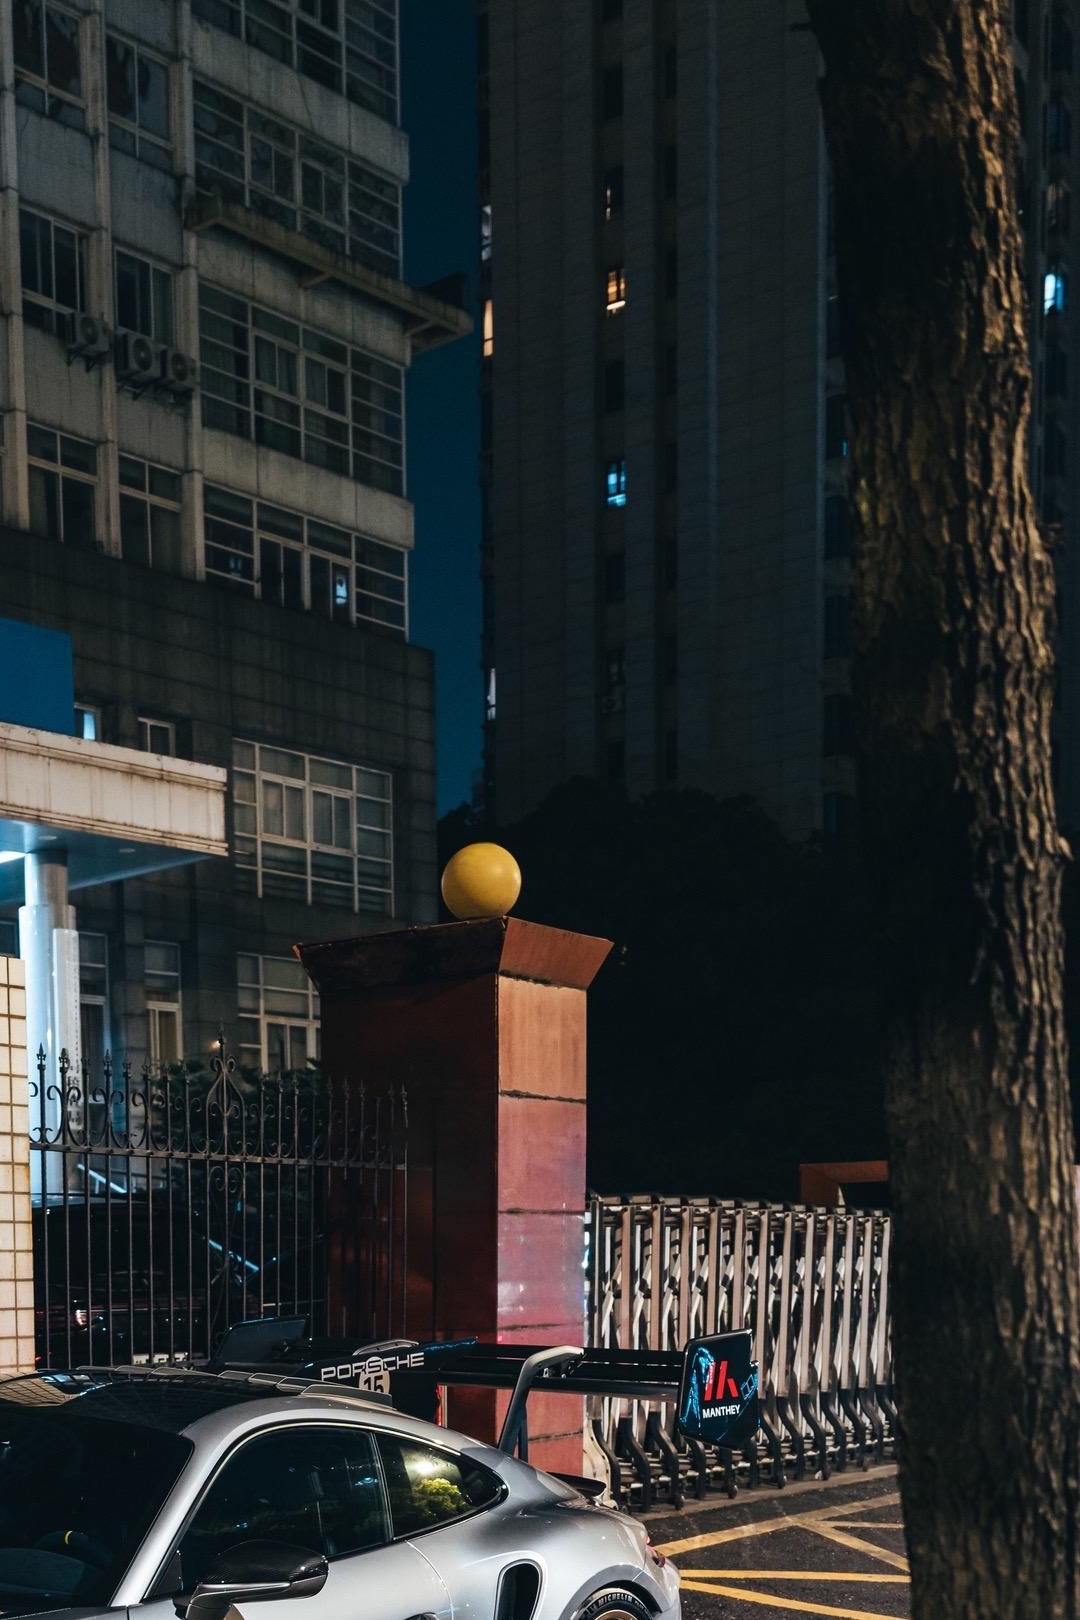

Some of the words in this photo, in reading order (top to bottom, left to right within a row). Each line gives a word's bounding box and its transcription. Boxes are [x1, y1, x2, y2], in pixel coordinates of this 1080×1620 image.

[321, 1351, 425, 1382] PORSCHE
[702, 1404, 741, 1419] MANTHEY
[598, 1593, 633, 1606] MICHELIN
